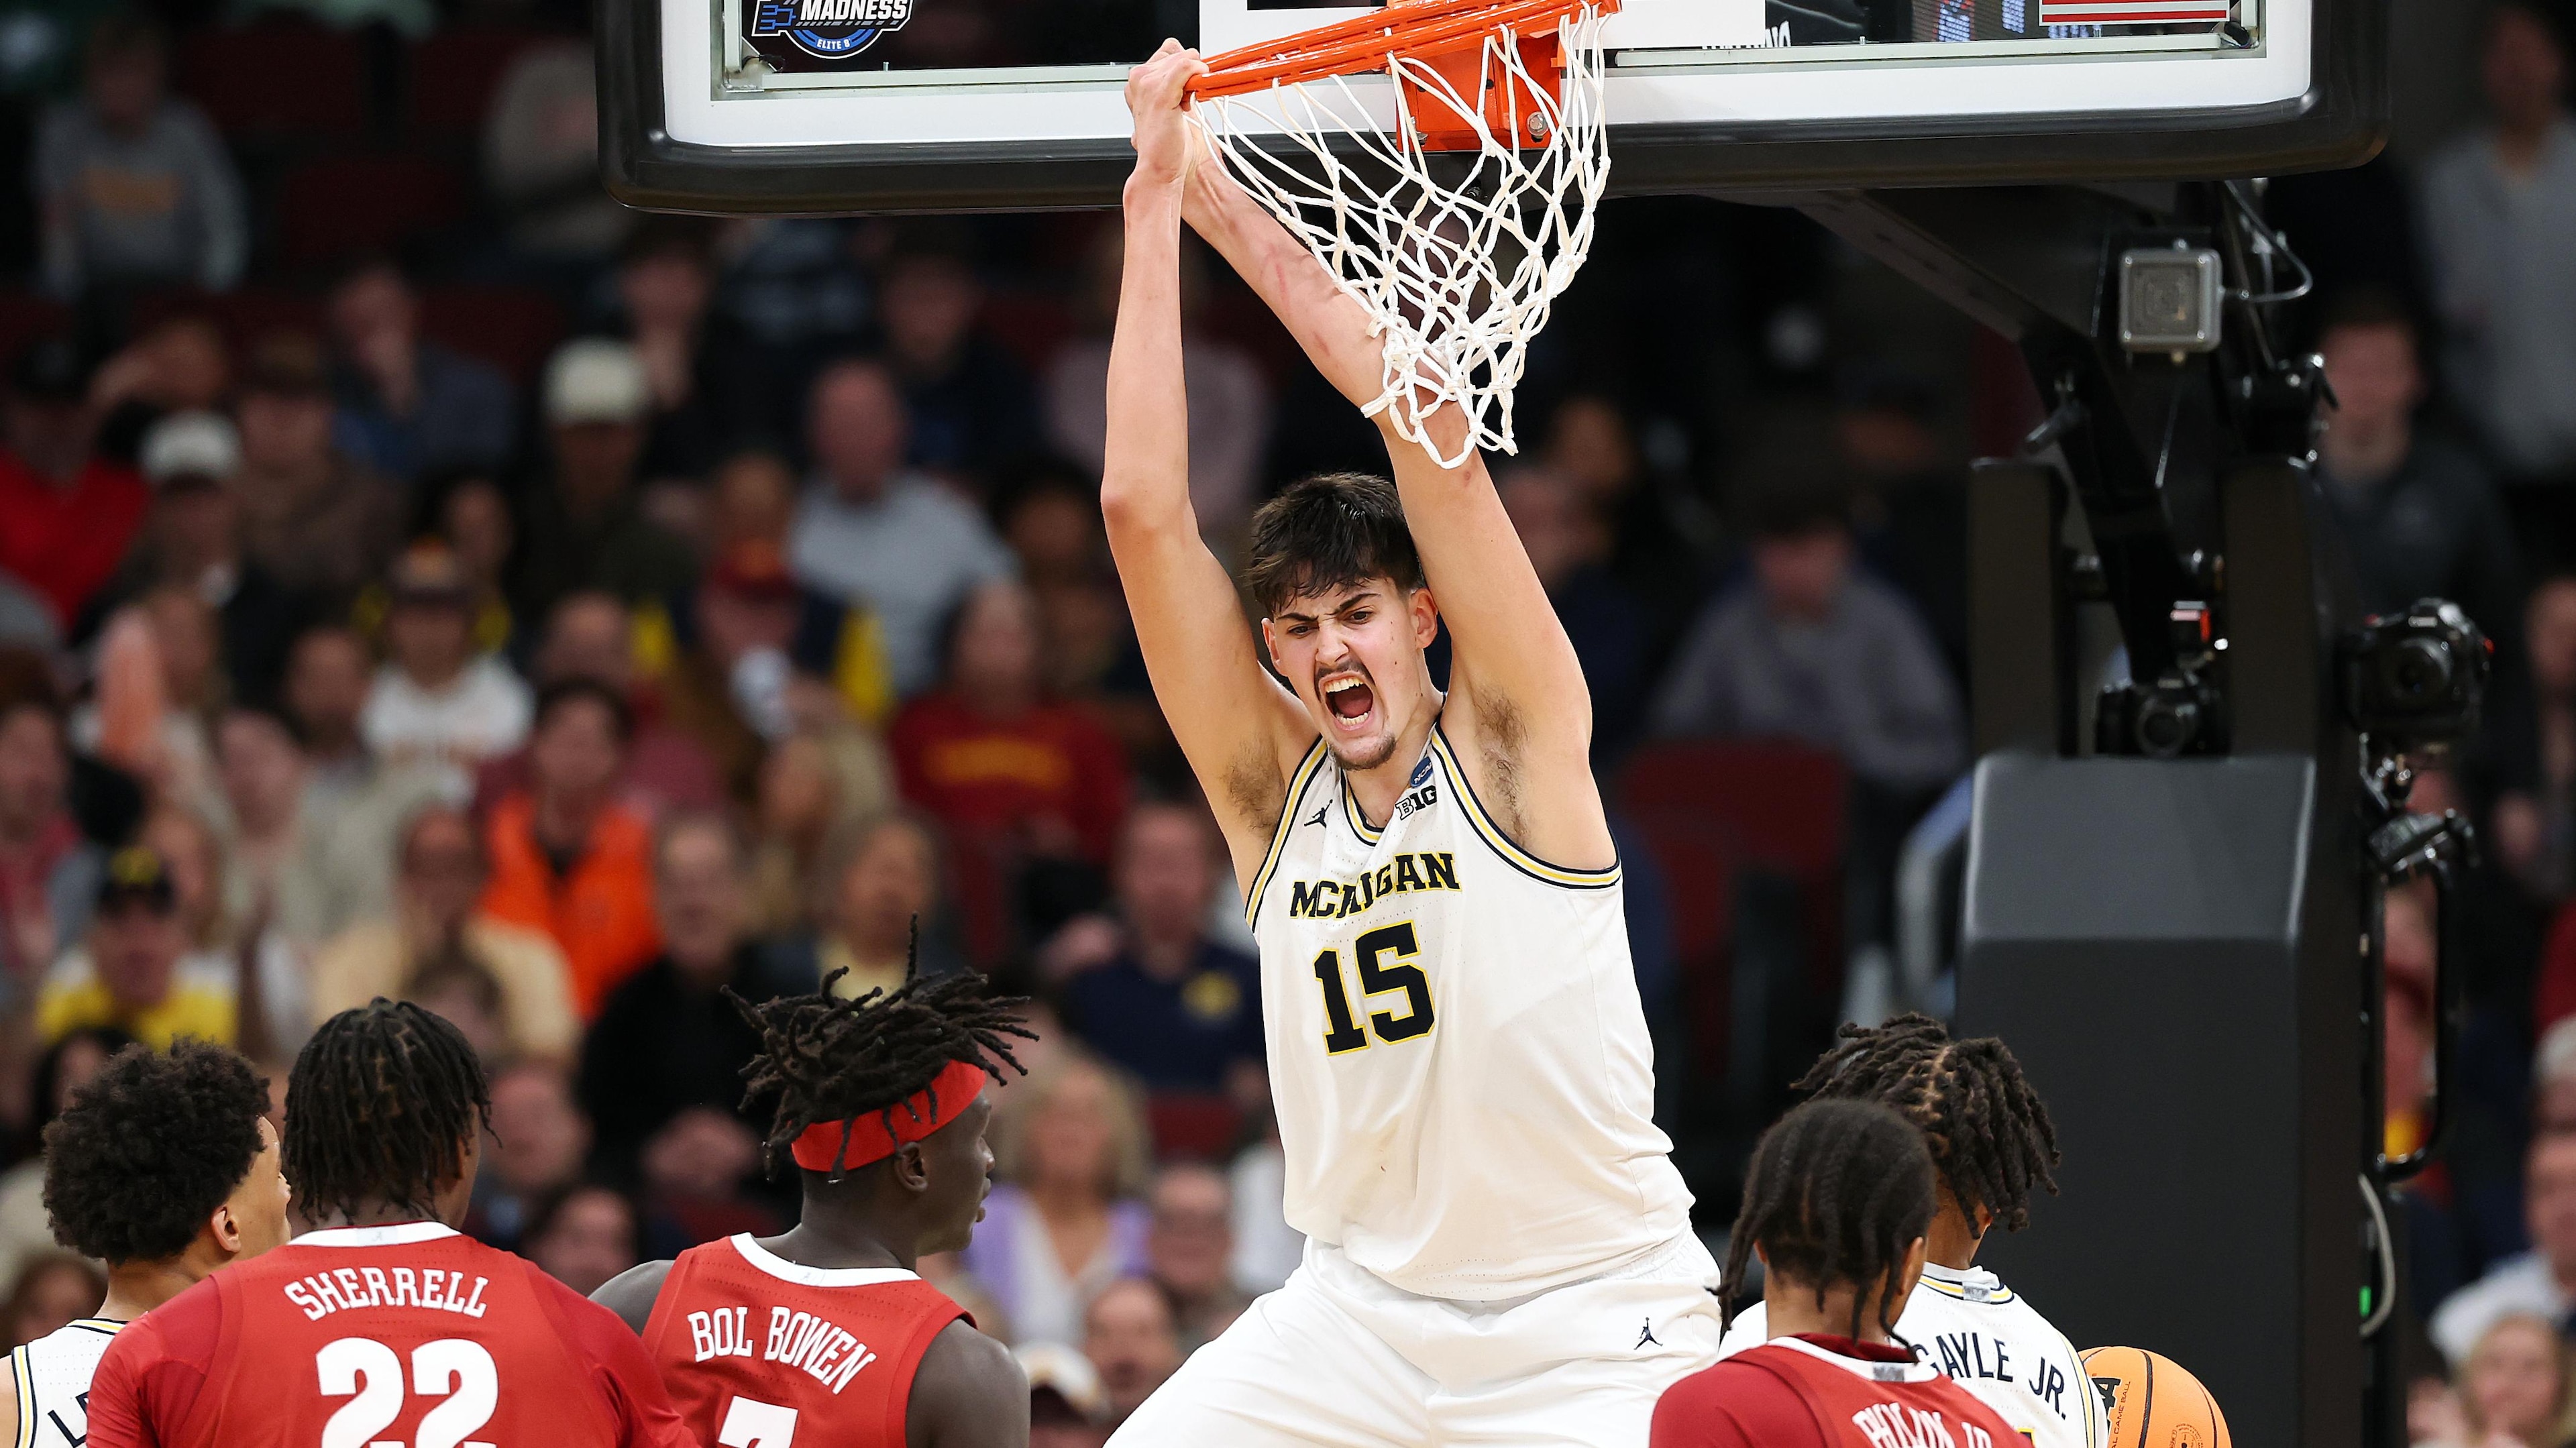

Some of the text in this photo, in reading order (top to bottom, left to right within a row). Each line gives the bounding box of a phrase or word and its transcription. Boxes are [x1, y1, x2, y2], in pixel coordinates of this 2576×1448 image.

[800, 0, 907, 20] MADNESS
[816, 38, 851, 50] ELITE 8
[1313, 920, 1436, 1056] 15
[284, 1267, 488, 1321] SHERRELL
[687, 1306, 877, 1394] BOL BOWEN
[315, 1337, 499, 1448] 22
[2029, 1356, 2066, 1421] JR.
[2114, 1404, 2125, 1435] GAME
[2121, 1381, 2131, 1403] BALL
